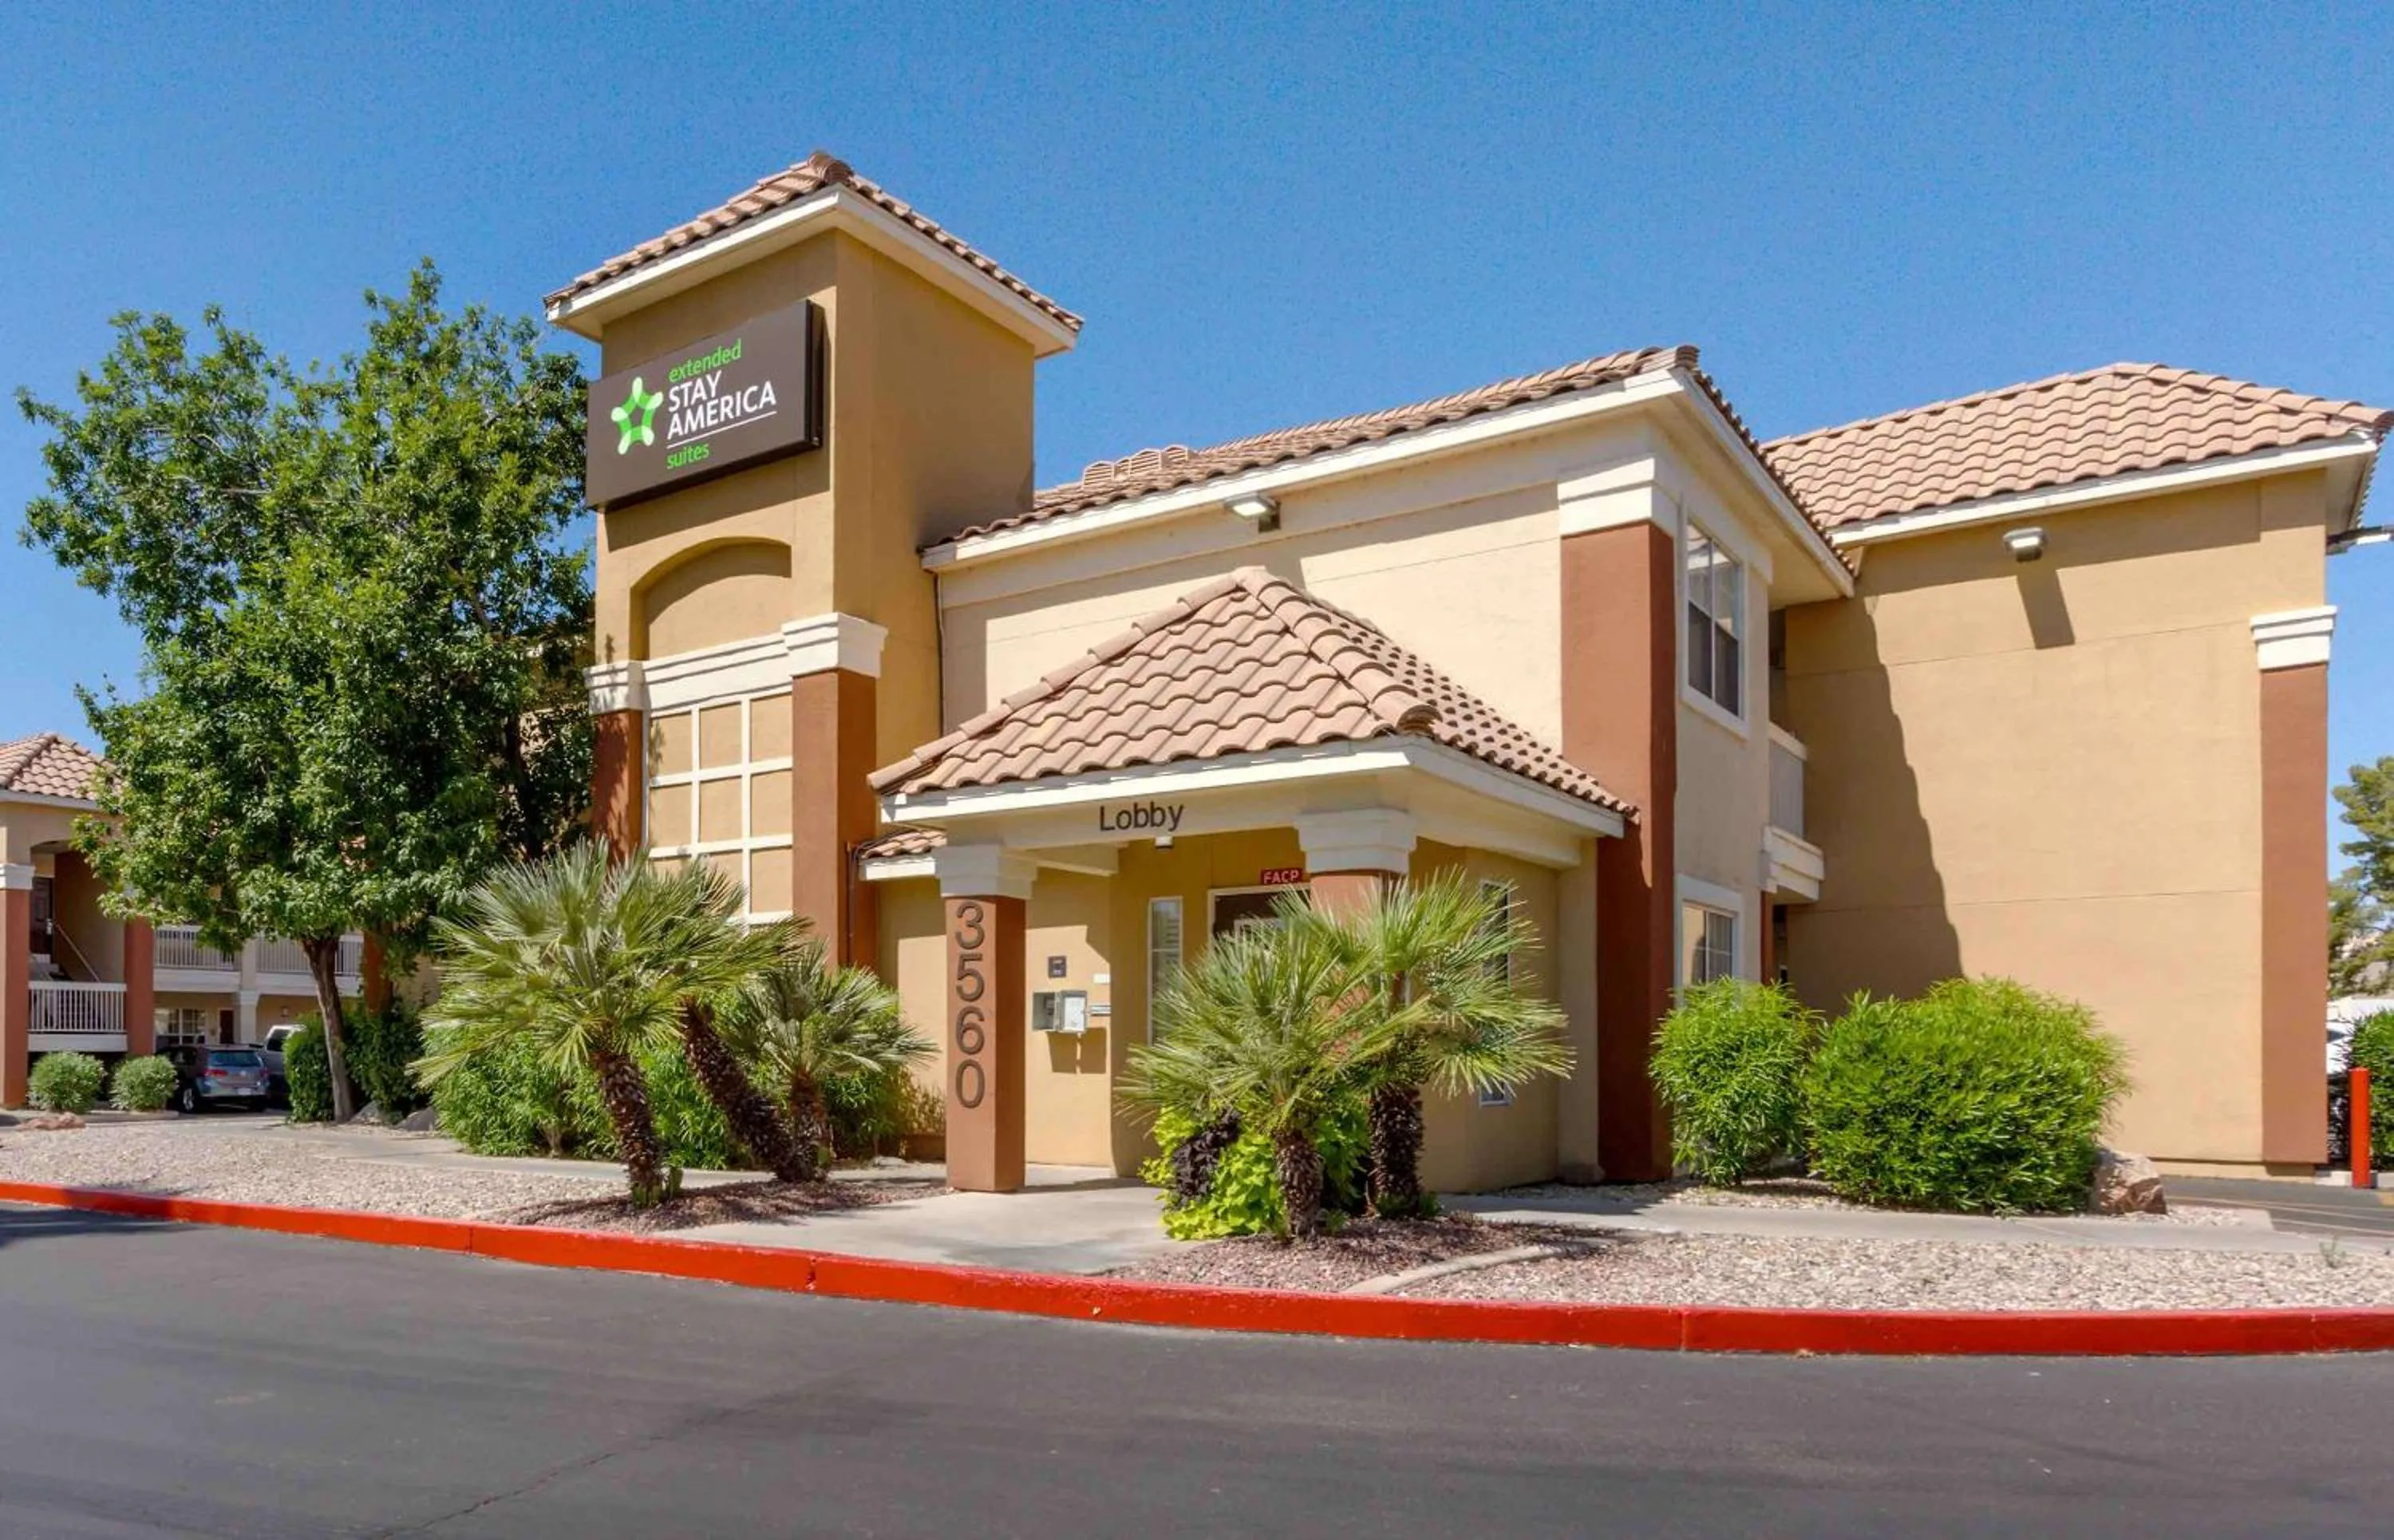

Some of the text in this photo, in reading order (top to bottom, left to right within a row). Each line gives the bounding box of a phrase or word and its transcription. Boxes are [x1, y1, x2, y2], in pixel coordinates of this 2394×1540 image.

[668, 338, 741, 383] extended
[666, 381, 777, 440] AMERICA
[668, 369, 721, 413] STAY
[666, 443, 709, 470] suites
[1100, 800, 1184, 831] Lobby
[1263, 870, 1300, 884] FACP
[955, 901, 986, 1109] 3560
